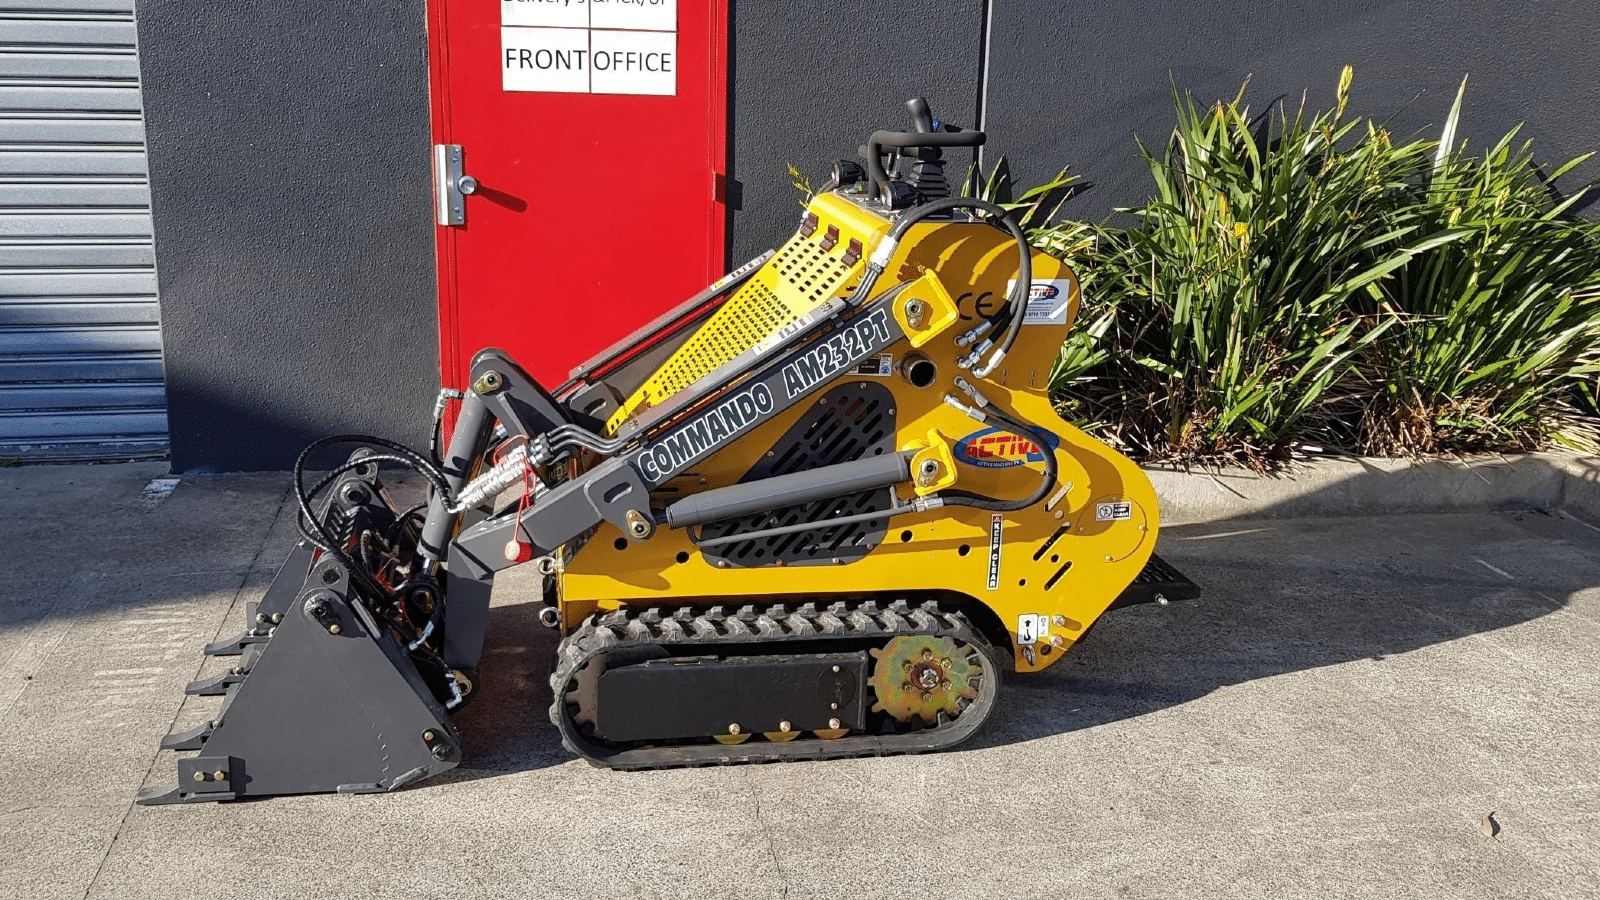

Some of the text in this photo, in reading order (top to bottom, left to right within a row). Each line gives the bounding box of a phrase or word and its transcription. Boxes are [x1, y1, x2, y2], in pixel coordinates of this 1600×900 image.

[505, 48, 672, 72] FRONT OFFICE
[637, 308, 891, 482] COMMANDO AM232PT
[989, 522, 1000, 587] KEEP CLEAR
